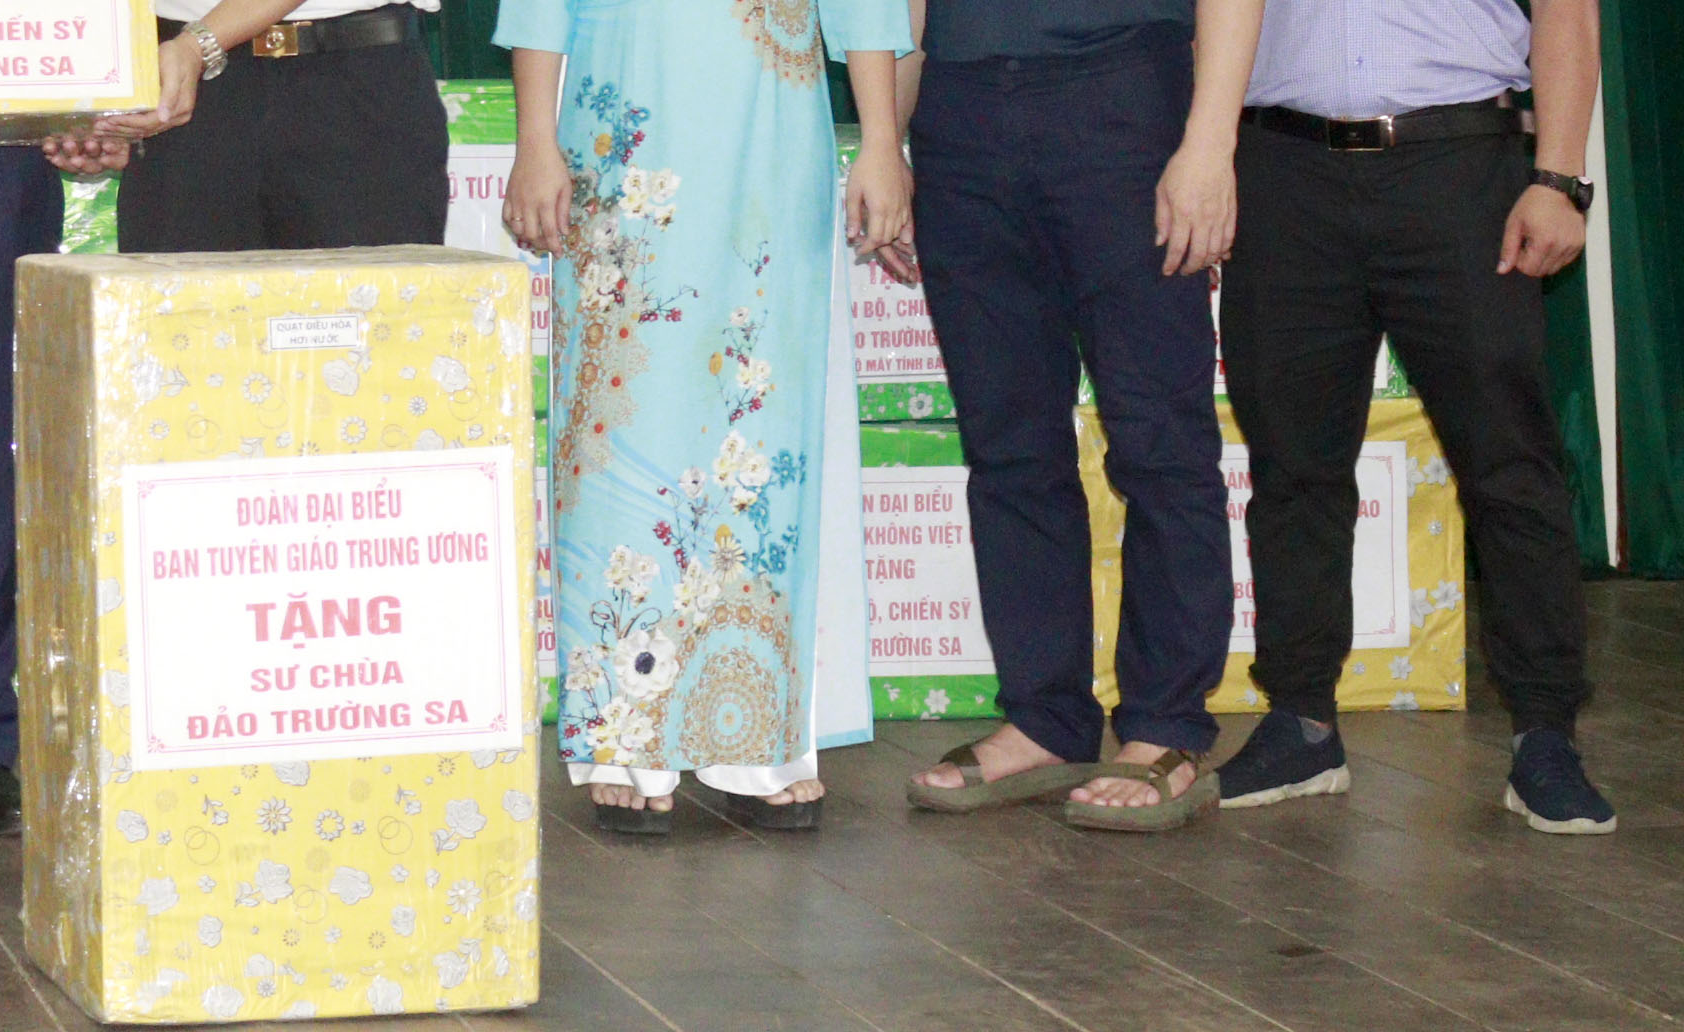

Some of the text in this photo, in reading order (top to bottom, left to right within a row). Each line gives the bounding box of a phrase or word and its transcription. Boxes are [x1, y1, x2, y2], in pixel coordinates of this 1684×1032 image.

[54, 16, 87, 40] SỸ
[40, 56, 75, 77] SA
[448, 171, 459, 204] Ộ
[465, 174, 494, 199] TƯ
[897, 299, 933, 317] CHI
[236, 477, 403, 528] ĐOÀN ĐẠI BIỂU
[880, 494, 908, 517] ĐẠI
[914, 484, 953, 513] BIỂU
[863, 522, 923, 545] KHÔNG
[928, 521, 963, 549] VIỆT
[153, 530, 489, 580] BAN TUYÊN GIÁO TRUNG ƯƠNG
[865, 555, 916, 584] TẶNG
[246, 591, 403, 649] TẶNG
[869, 594, 971, 626] Ộ, CHIẾN SỸ
[870, 631, 963, 657] RƯỜNG SA
[250, 656, 404, 692] SƯ CHÙA
[187, 699, 469, 740] ĐẢO TRƯỜNG SA
